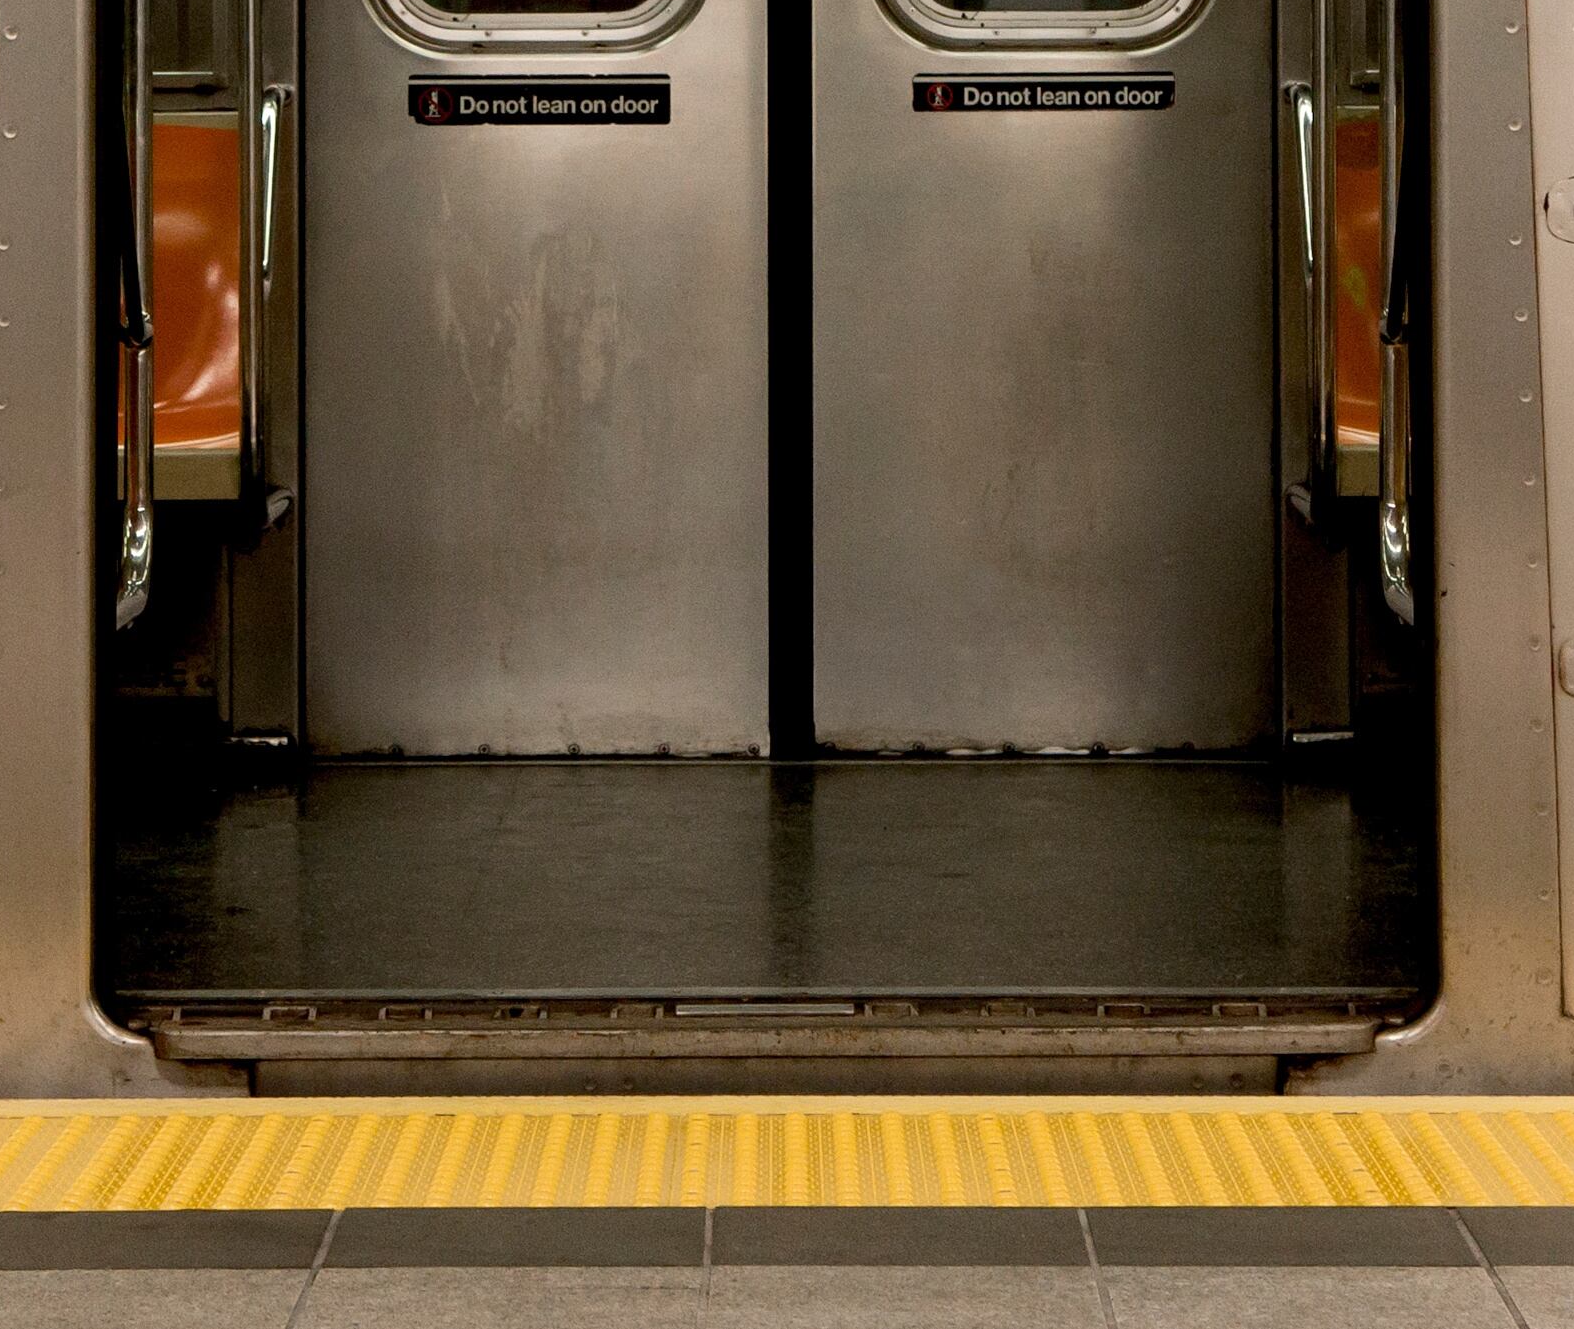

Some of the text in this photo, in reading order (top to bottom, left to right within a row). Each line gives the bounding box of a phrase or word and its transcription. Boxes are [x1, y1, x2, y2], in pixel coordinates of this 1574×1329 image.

[459, 95, 659, 114] Do not lean on door
[963, 86, 1163, 106] Do not lean on door
